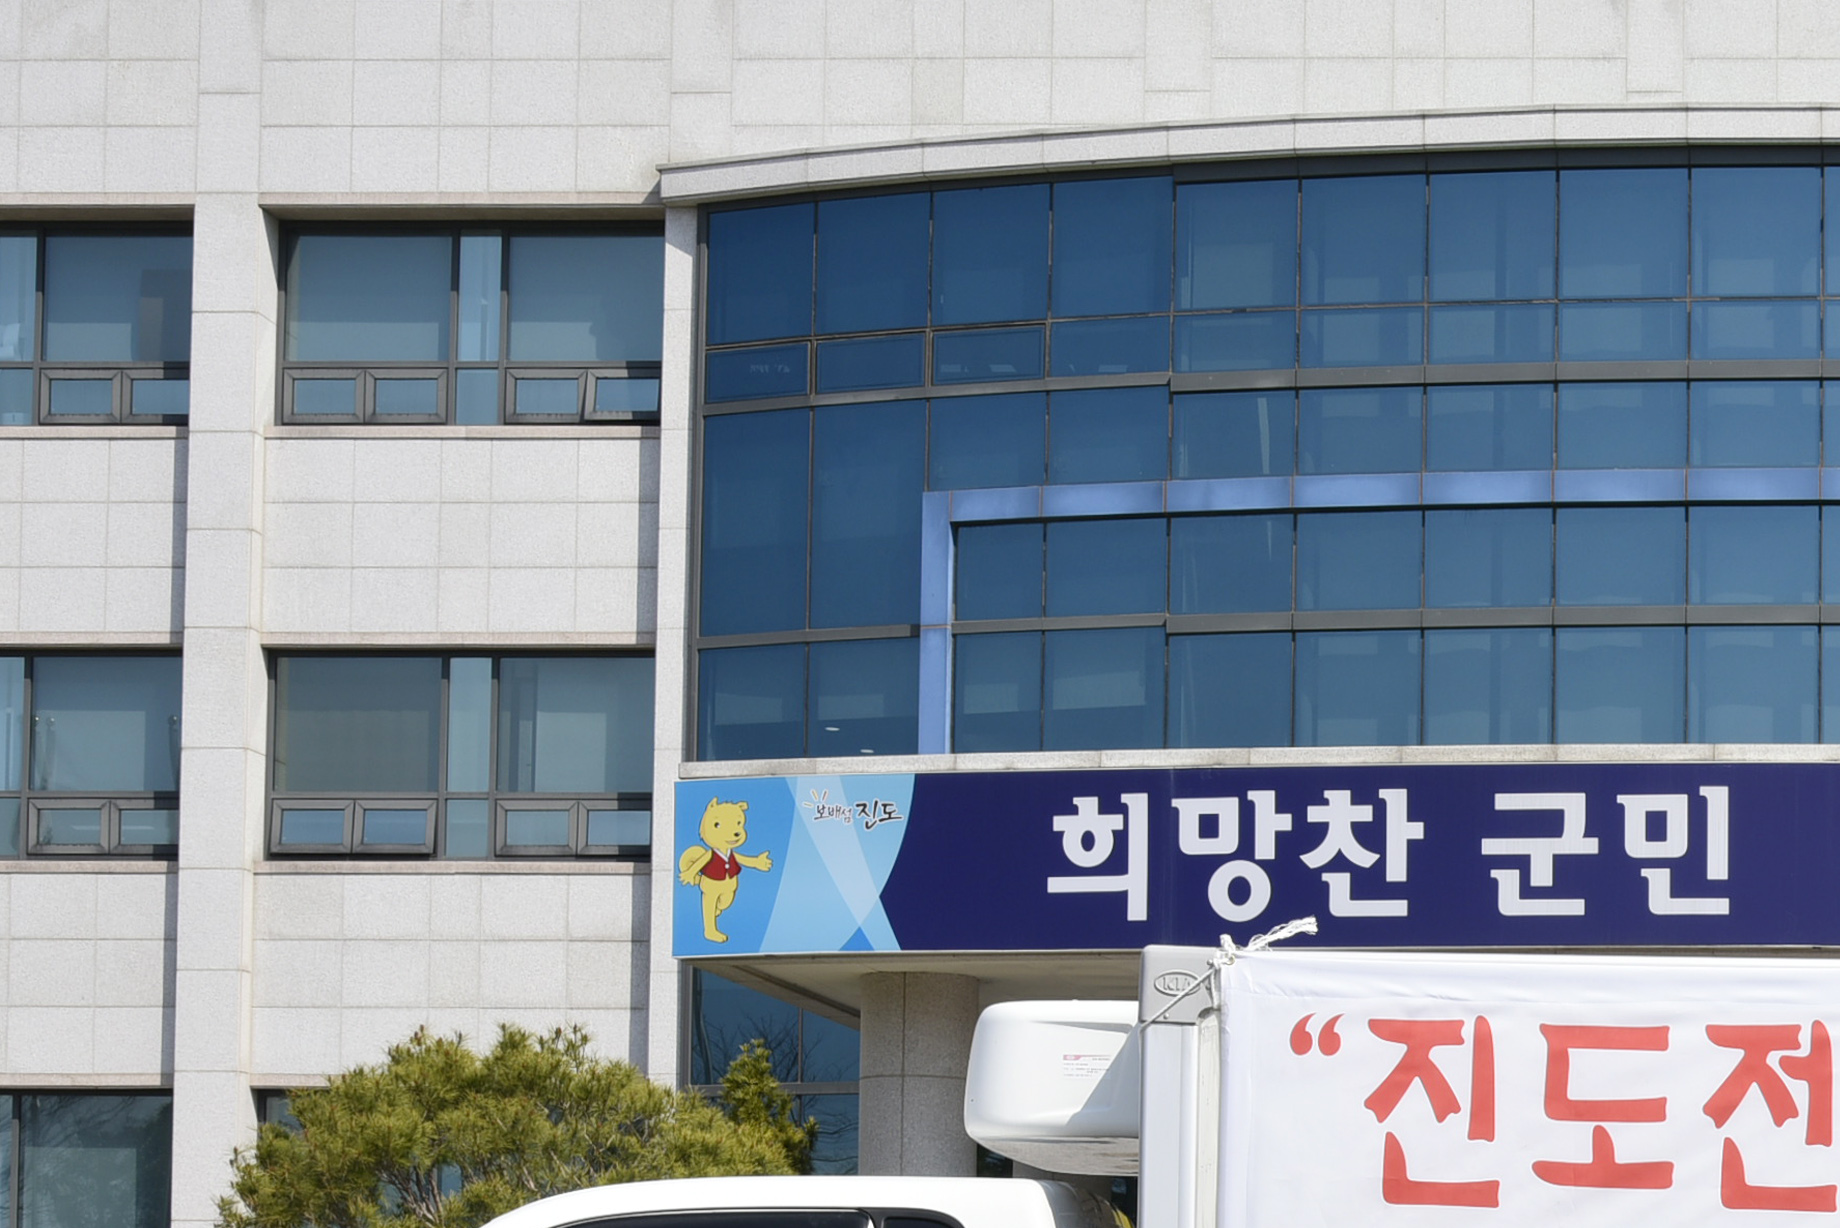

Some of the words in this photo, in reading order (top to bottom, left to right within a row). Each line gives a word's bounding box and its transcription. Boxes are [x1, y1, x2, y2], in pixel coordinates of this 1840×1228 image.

[855, 799, 903, 831] 진도
[1047, 788, 1424, 922] 희망찬
[1481, 786, 1730, 916] 군민
